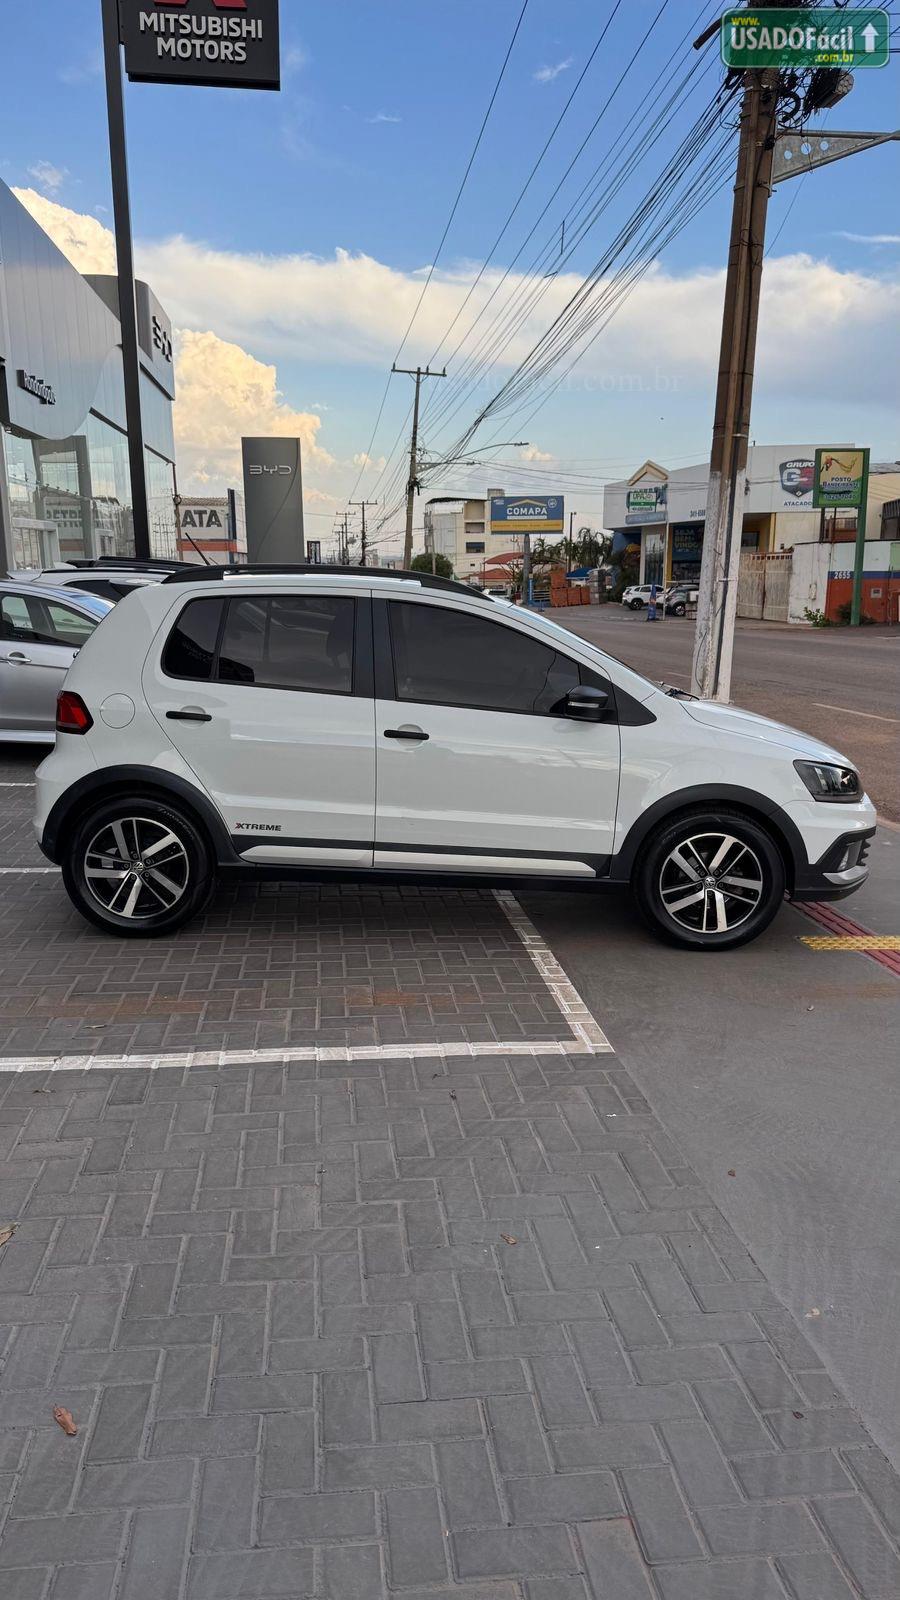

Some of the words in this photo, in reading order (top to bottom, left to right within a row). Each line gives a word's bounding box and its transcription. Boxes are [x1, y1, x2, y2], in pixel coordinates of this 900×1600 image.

[139, 11, 263, 39] MITSUBISHI
[157, 37, 247, 62] MOTORS
[249, 465, 292, 475] BYD
[506, 507, 548, 515] COMAPA
[175, 510, 223, 528] ATA
[834, 570, 851, 580] 2655
[235, 822, 282, 832] XTREME
